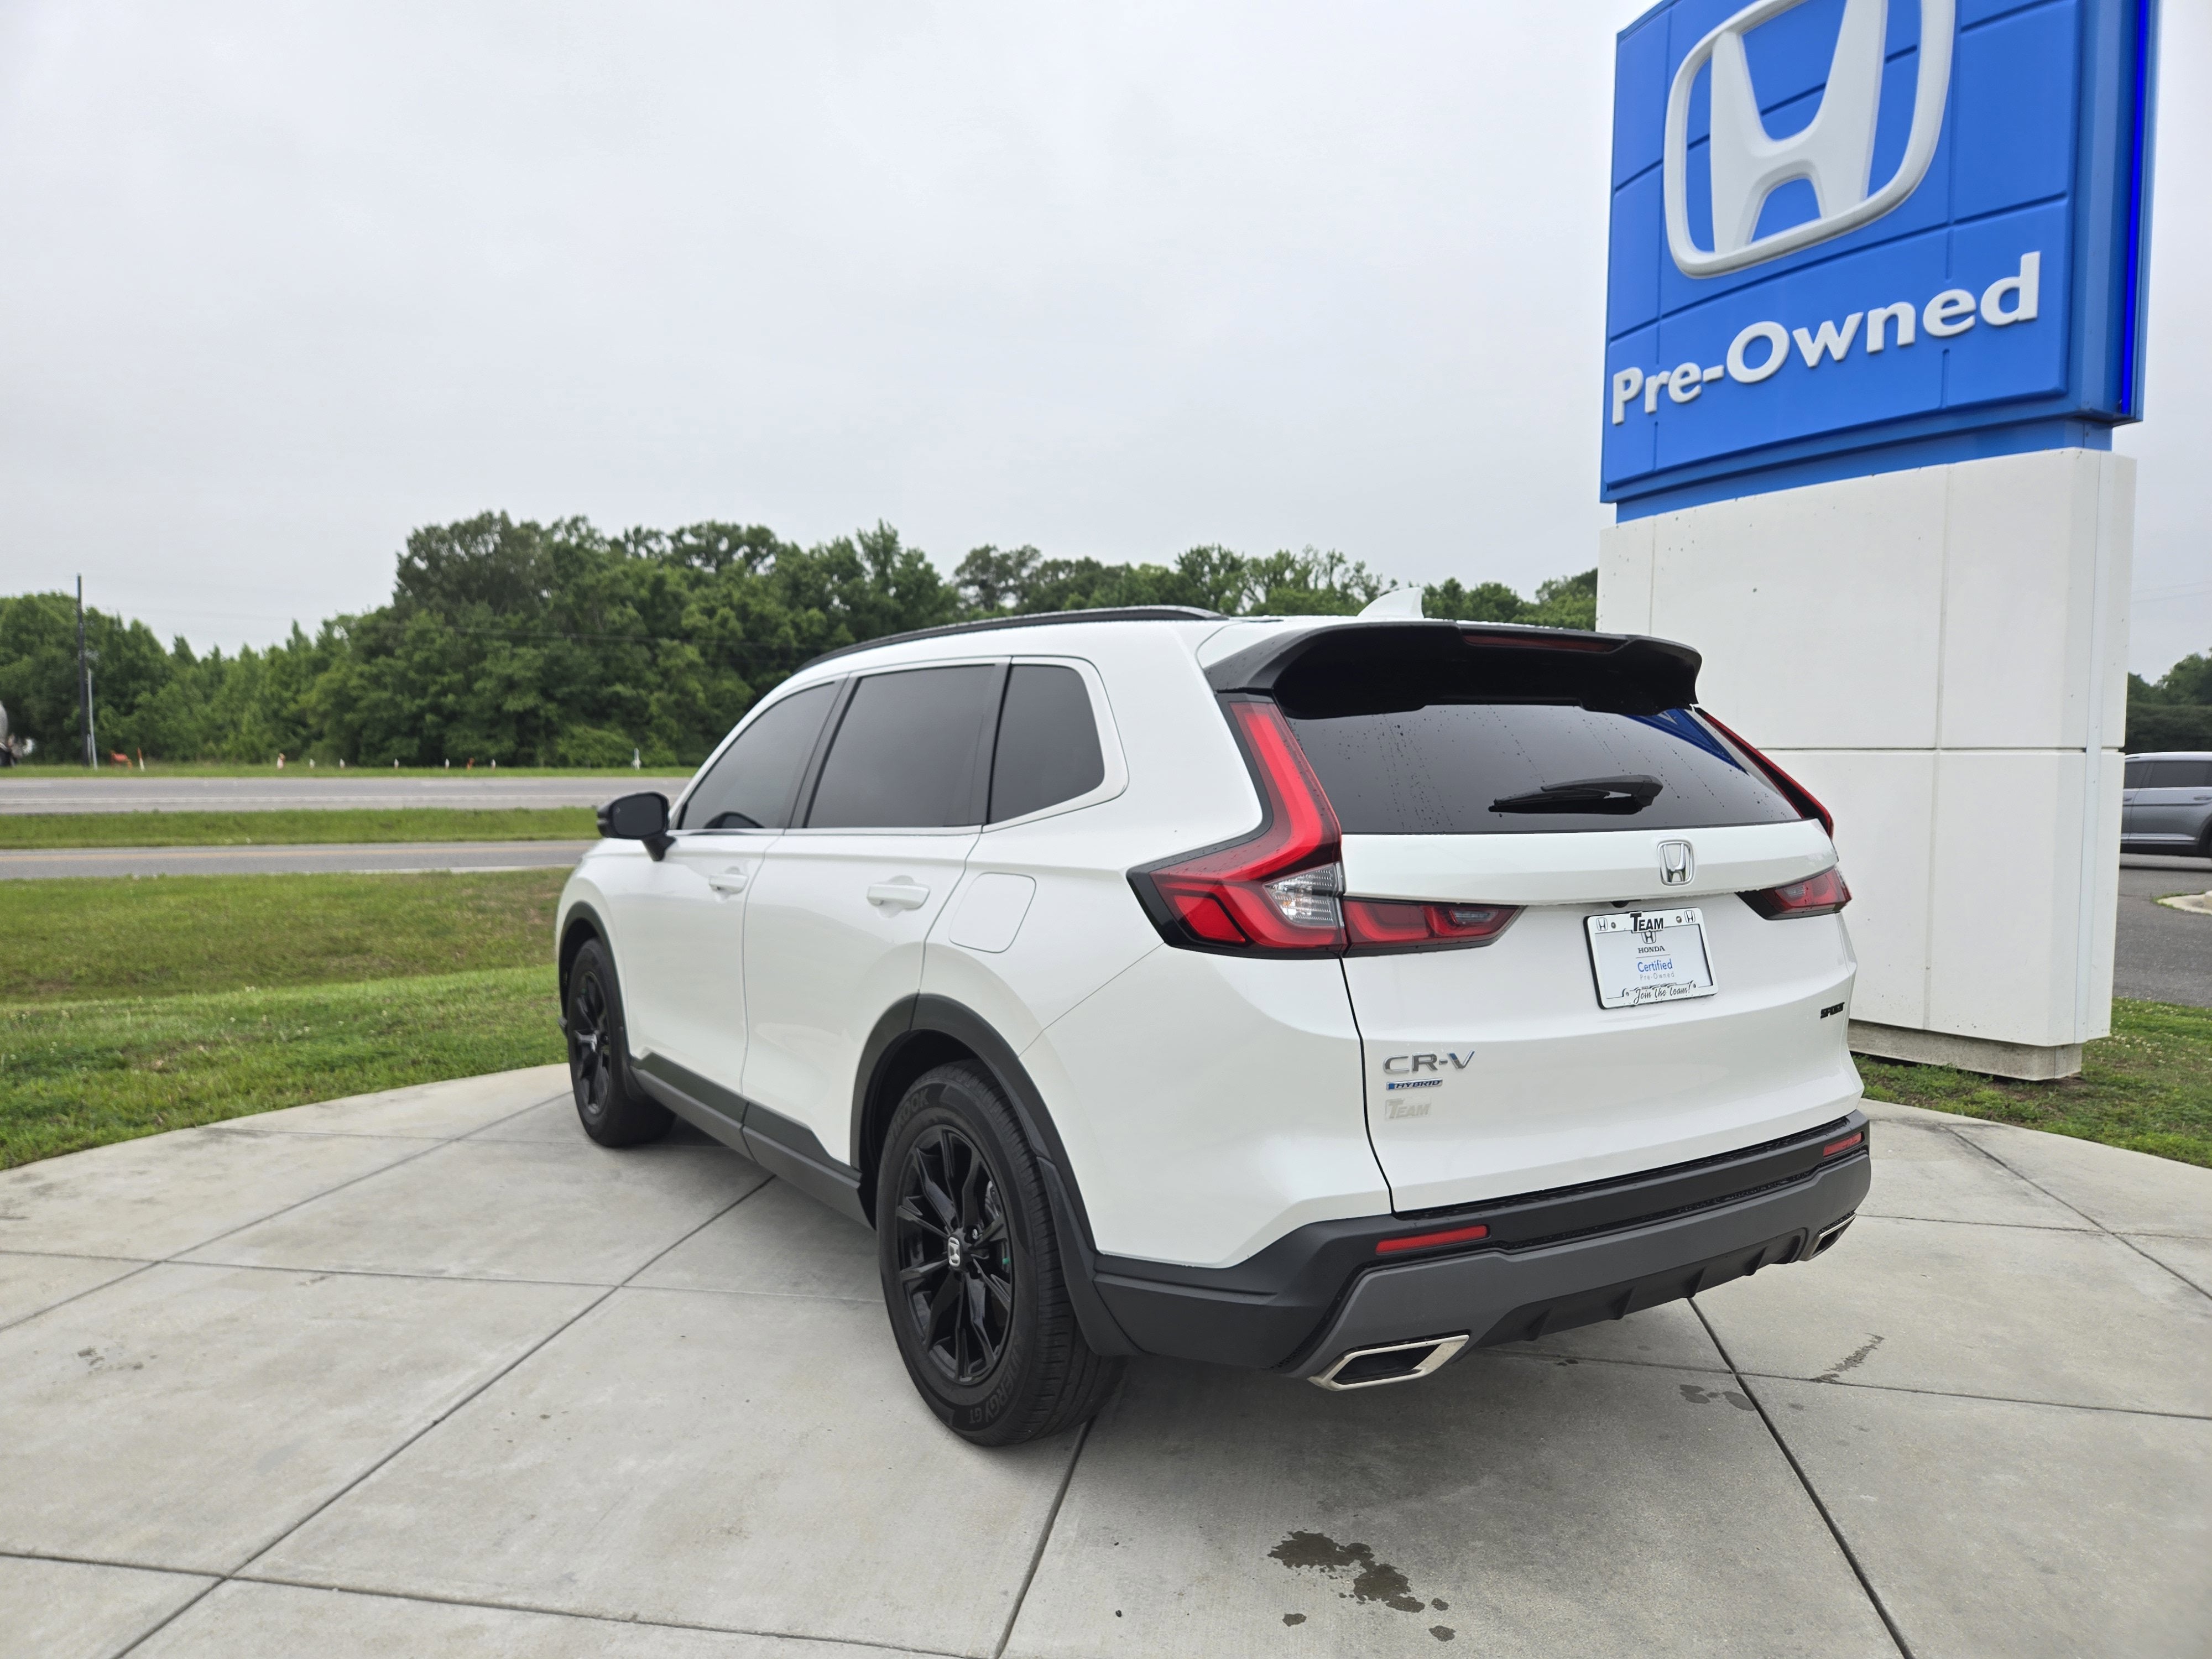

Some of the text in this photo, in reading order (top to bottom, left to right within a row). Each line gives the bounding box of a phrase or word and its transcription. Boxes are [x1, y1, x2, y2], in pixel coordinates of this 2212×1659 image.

[1611, 251, 2041, 425] Pre-Owned
[1630, 912, 1664, 932] TEAM
[1637, 958, 1673, 972] Certified
[1640, 971, 1675, 980] Pre-Owned
[1633, 987, 1651, 1004] Join
[1383, 1050, 1475, 1074] CR-V
[1395, 1079, 1441, 1089] HYBRID
[1388, 1098, 1432, 1119] TEAM
